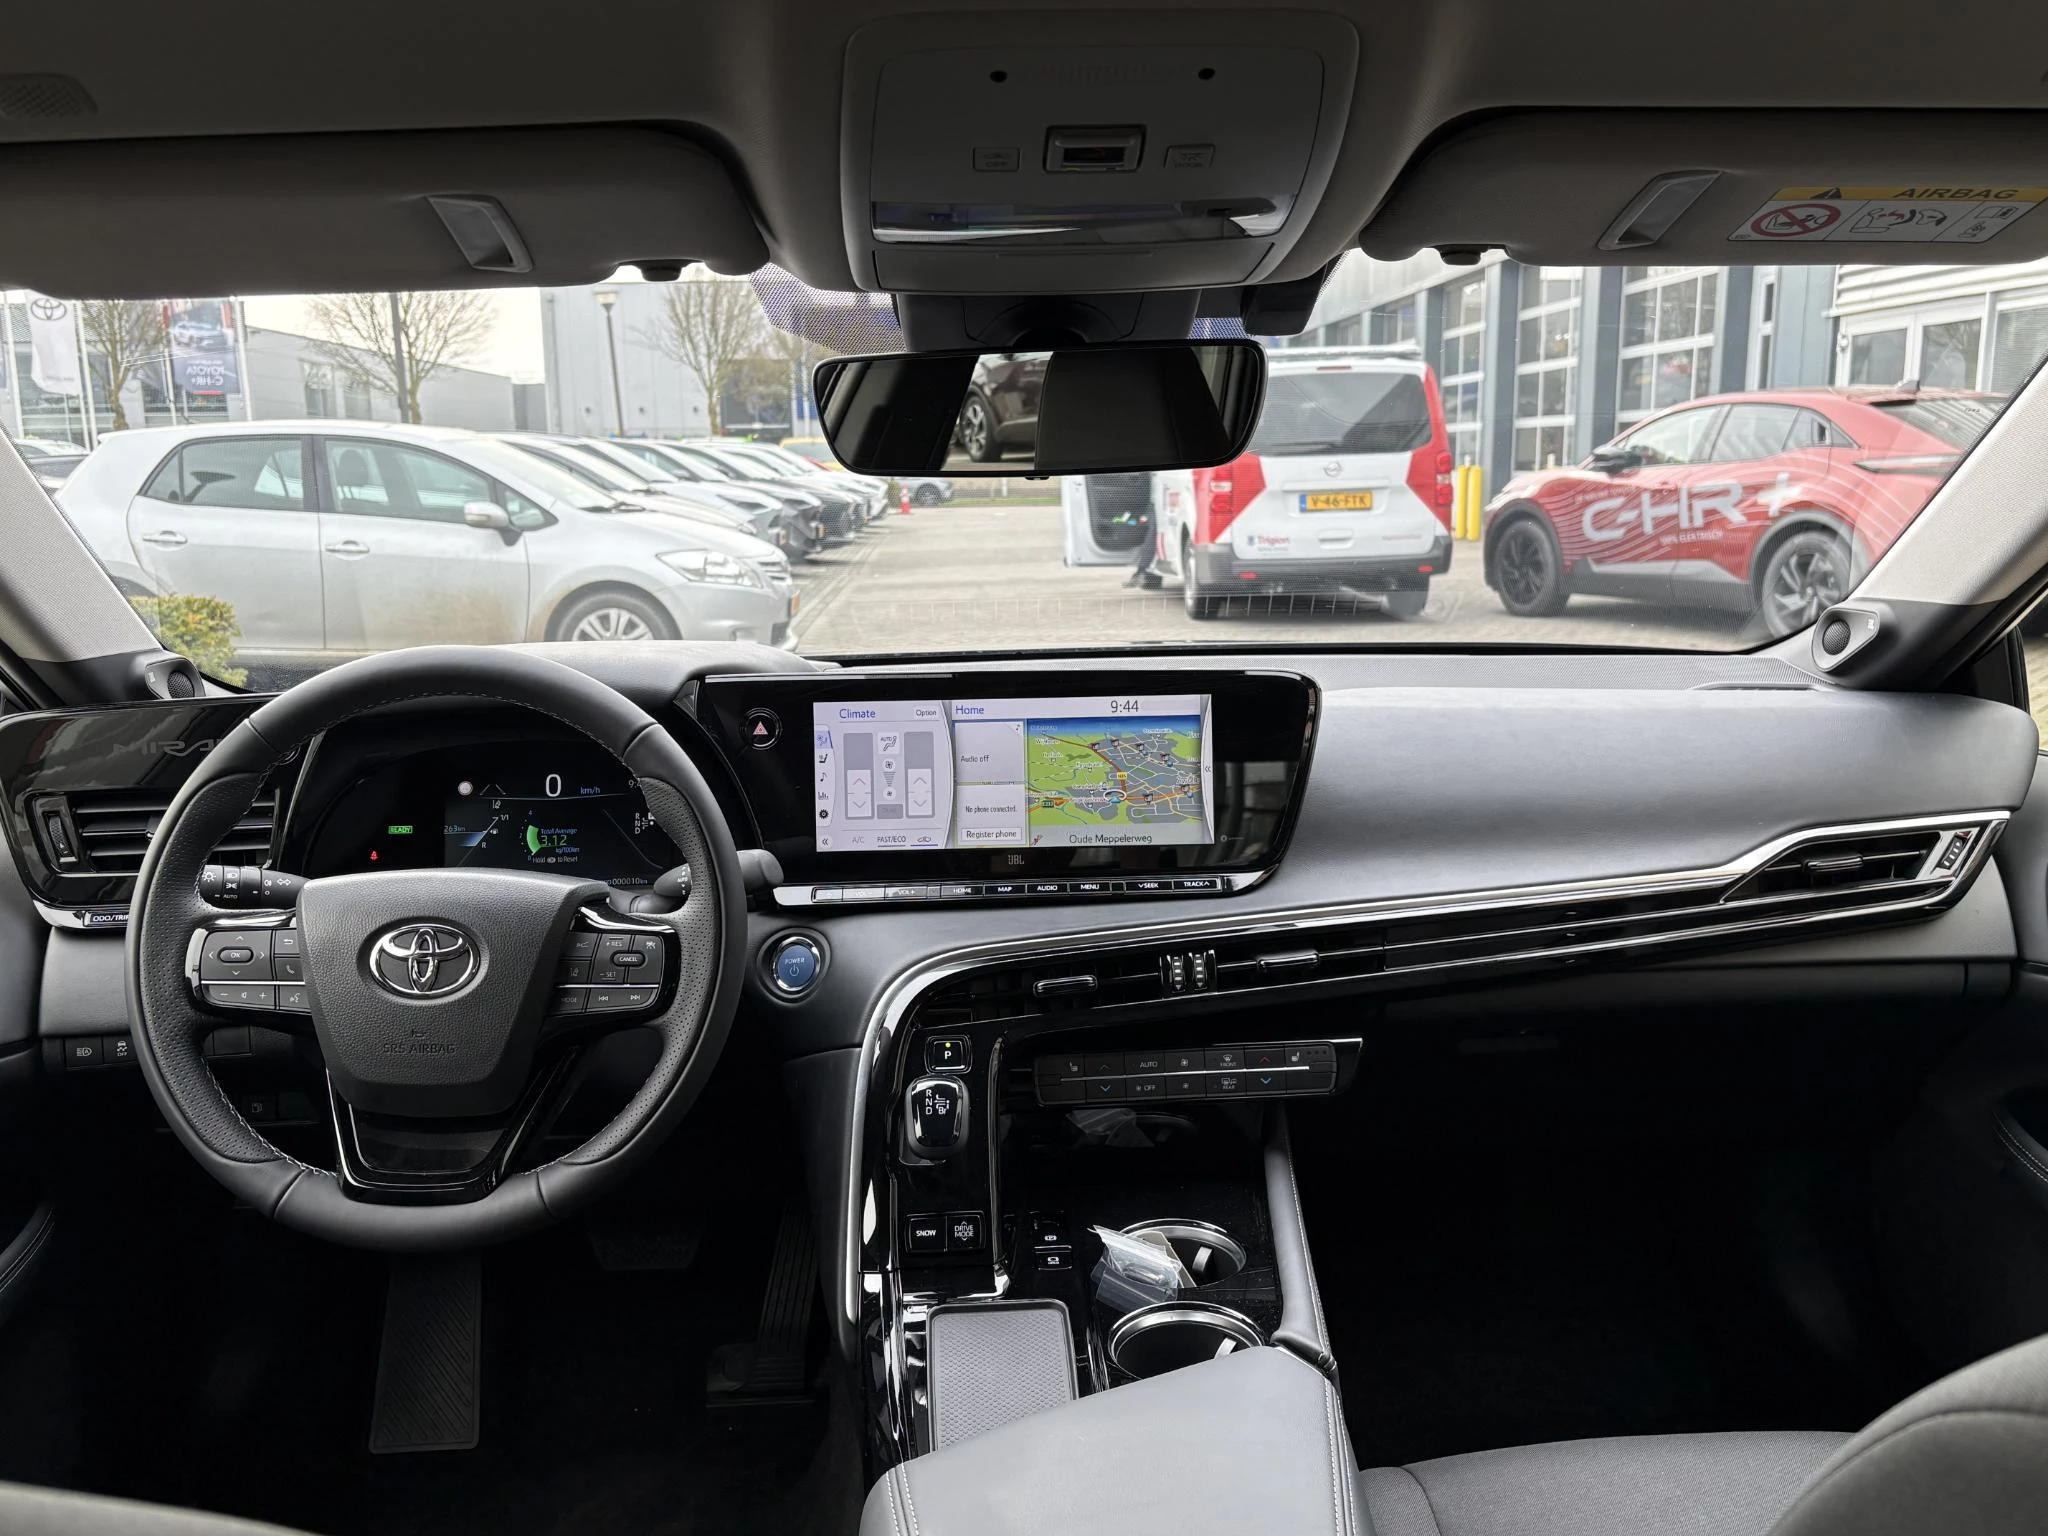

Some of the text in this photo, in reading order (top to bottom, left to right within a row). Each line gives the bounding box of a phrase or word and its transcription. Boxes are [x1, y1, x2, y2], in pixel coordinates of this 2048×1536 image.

[1893, 188, 2020, 200] AIRBAG
[955, 705, 985, 715] Home
[1110, 699, 1139, 713] 9:44
[839, 708, 937, 719] Climate Option
[545, 773, 562, 797] 0
[580, 786, 601, 795] km/h
[974, 806, 990, 814] phone
[554, 828, 578, 836] Average
[966, 829, 1017, 840] Register phone
[541, 835, 567, 846] 3.12
[852, 836, 864, 844] A/C
[1069, 834, 1153, 846] Oude Meppelerweg
[784, 957, 805, 965] POWER
[383, 1043, 456, 1054] SRS AIRBAG
[944, 1050, 952, 1060] P
[926, 1089, 932, 1097] R
[926, 1098, 933, 1106] N
[926, 1106, 933, 1115] D
